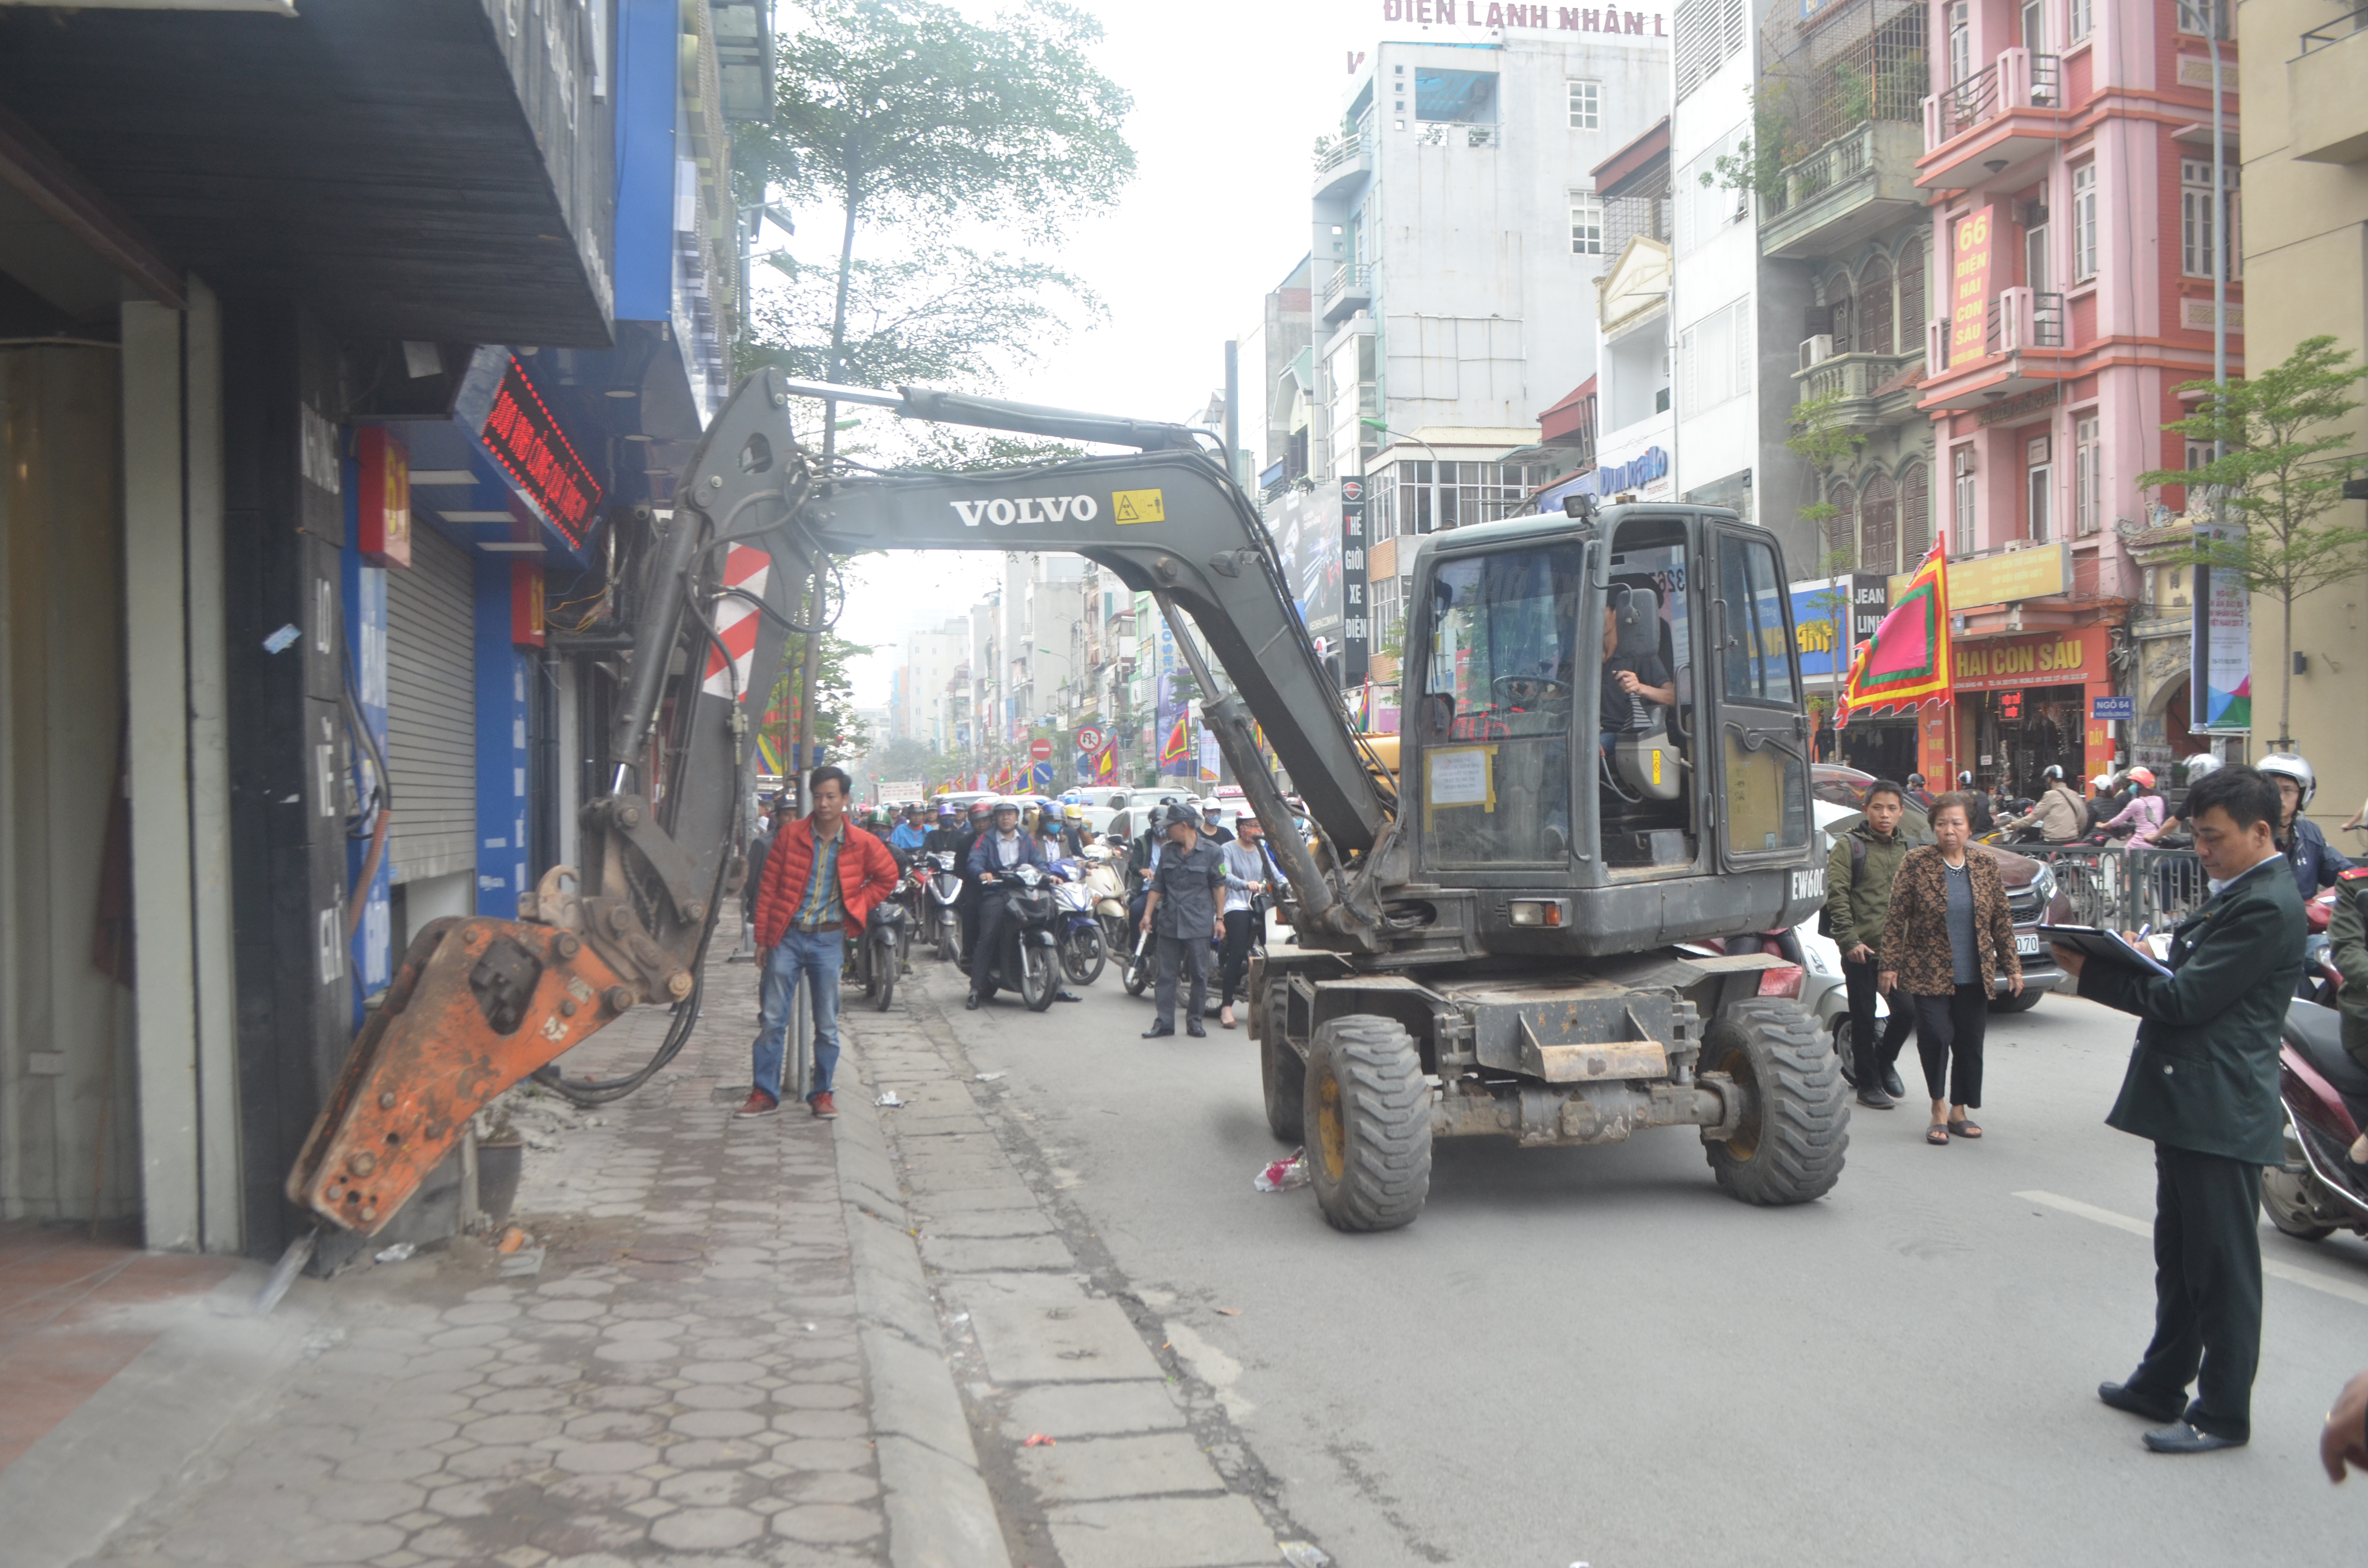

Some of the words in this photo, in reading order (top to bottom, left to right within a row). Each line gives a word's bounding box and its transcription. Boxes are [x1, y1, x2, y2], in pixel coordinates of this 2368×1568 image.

[1560, 3, 1644, 36] NHÂN
[1959, 214, 1987, 251] 66
[1957, 251, 1987, 279] ĐIỆN
[1960, 277, 1982, 299] HAI
[1956, 299, 1983, 323] CON
[1956, 322, 1982, 345] SÁU
[950, 495, 1098, 527] VOLVO
[1346, 510, 1362, 536] THẾ
[1346, 546, 1364, 570] GIỚI
[1349, 585, 1361, 604] XE
[1855, 588, 1885, 604] JEAN
[1345, 614, 1367, 642] ĐIỆN
[1956, 649, 1988, 678] HAI
[1993, 645, 2035, 675] CON
[2039, 636, 2083, 671] SÁU
[1792, 868, 1825, 900] EW60C
